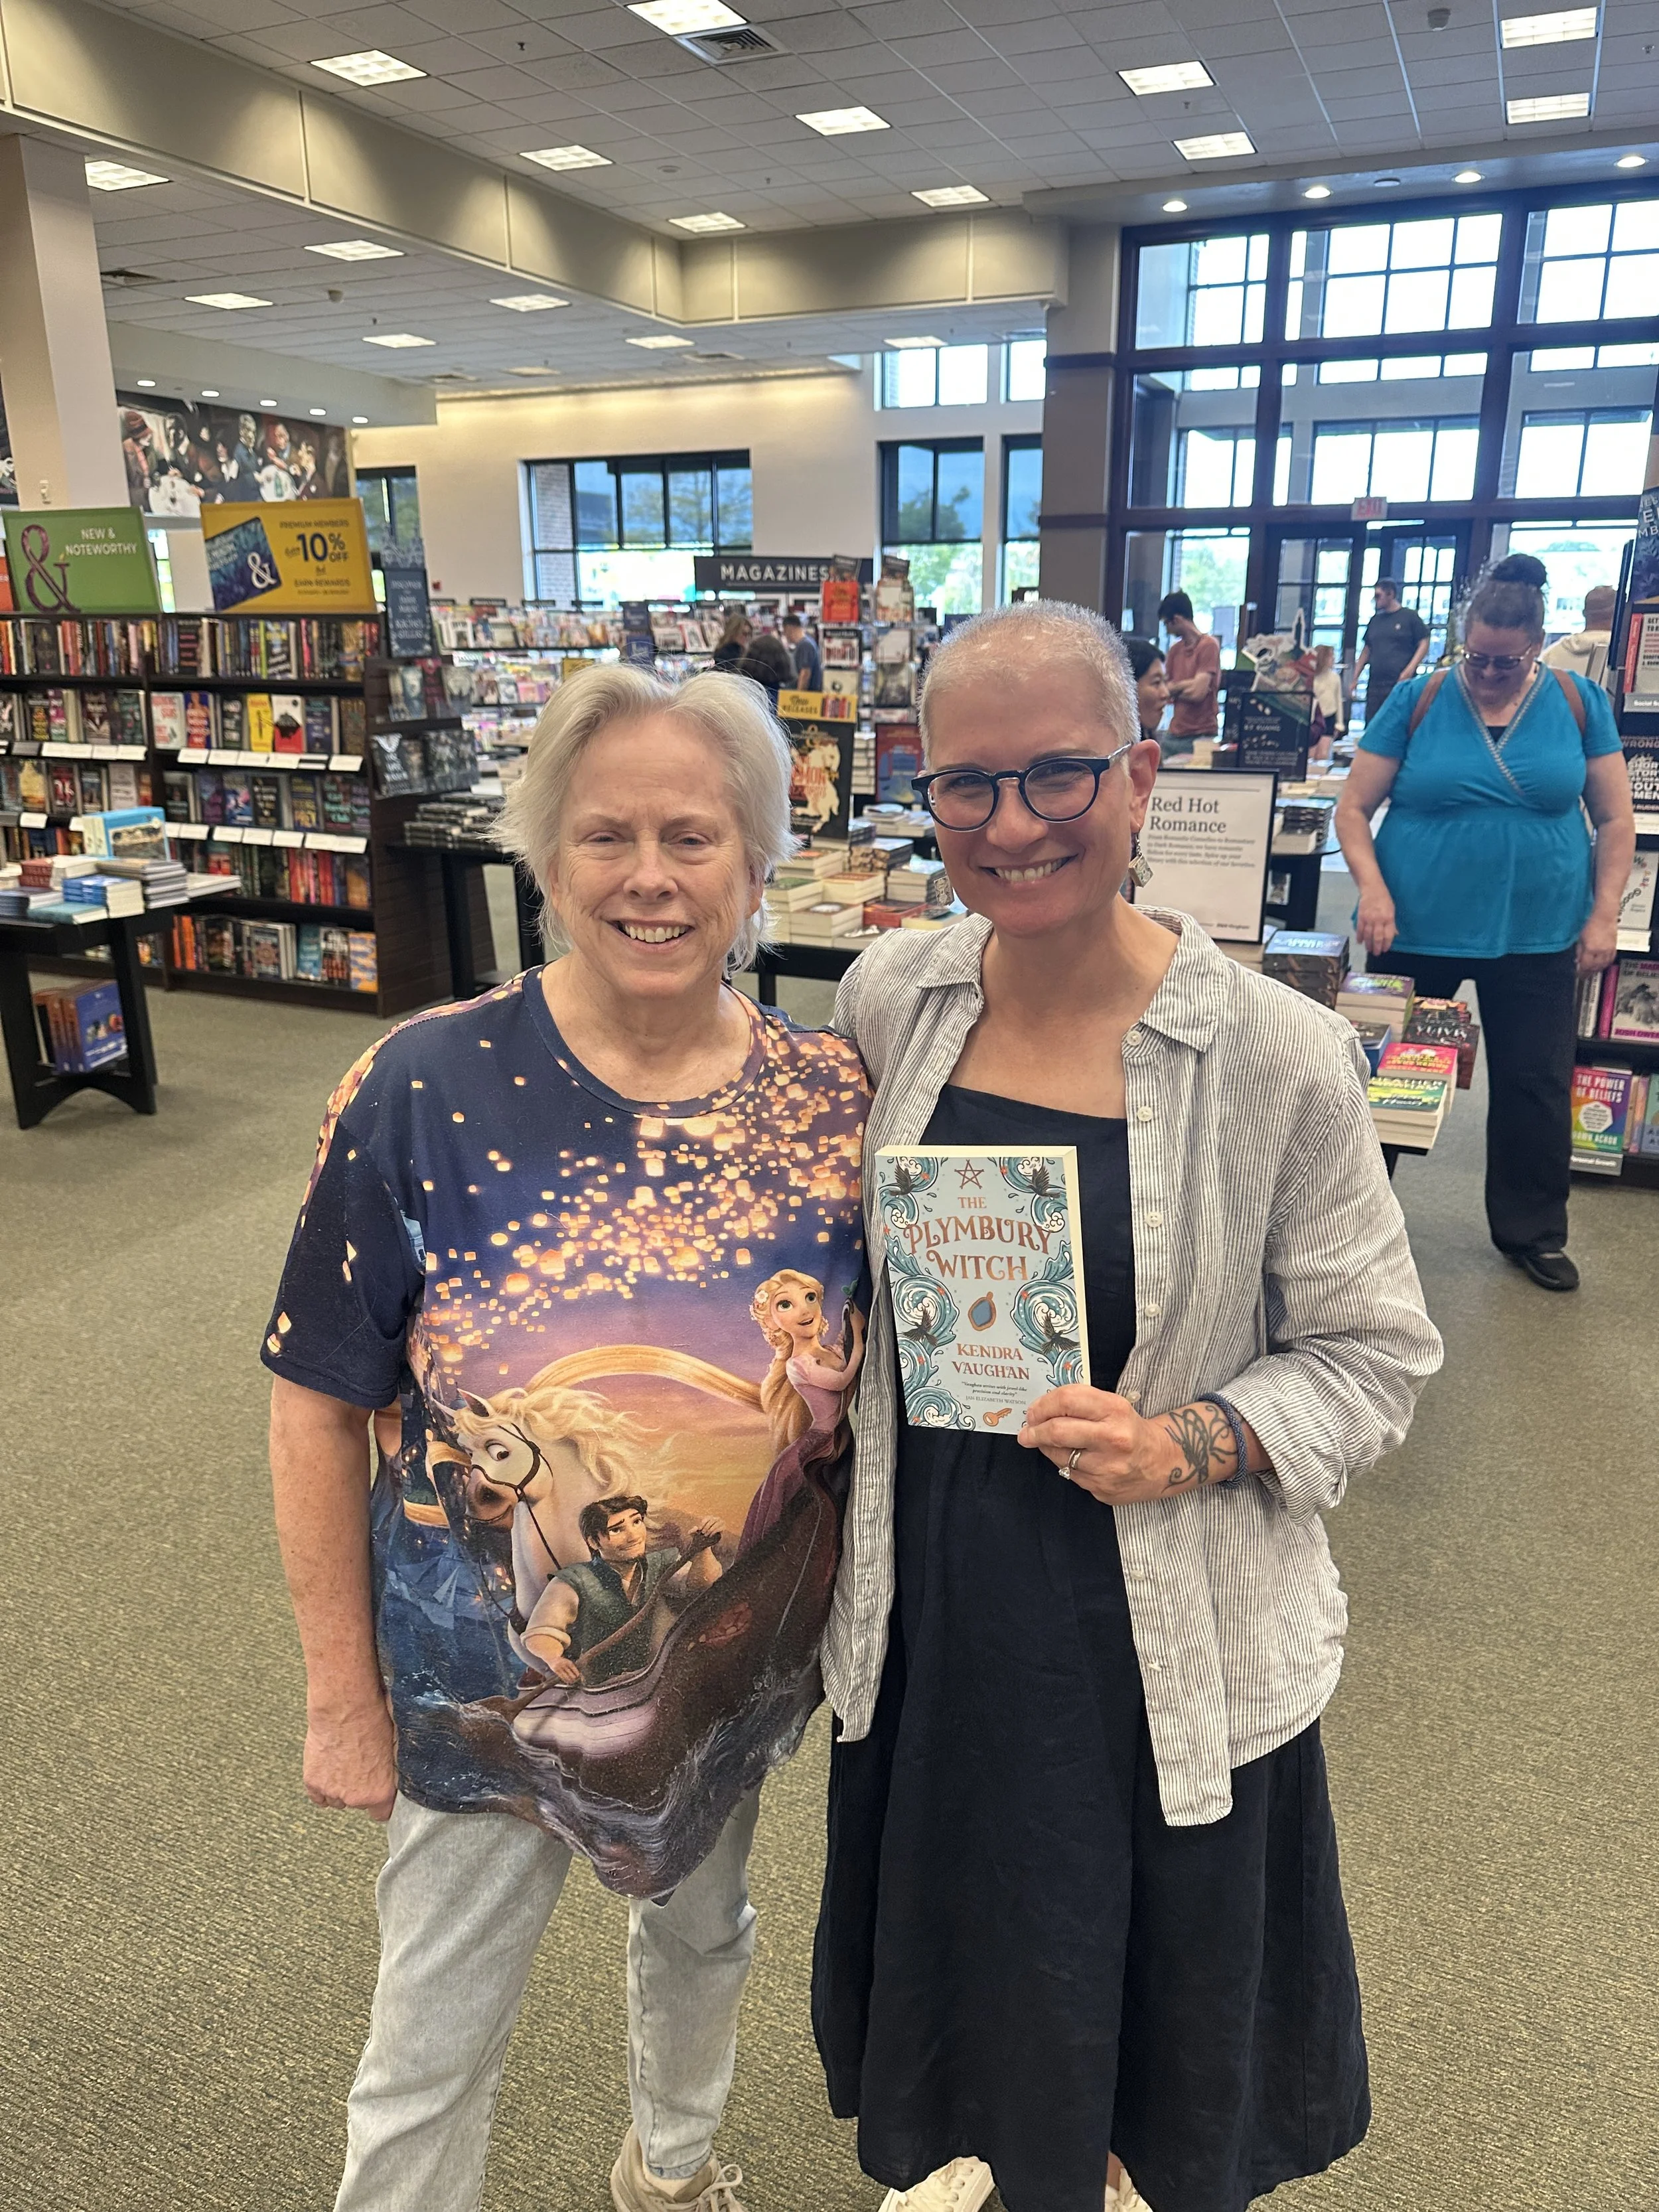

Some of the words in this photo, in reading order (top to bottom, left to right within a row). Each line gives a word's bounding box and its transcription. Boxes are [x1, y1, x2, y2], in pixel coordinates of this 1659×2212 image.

[280, 520, 311, 529] PREMIUM
[313, 519, 350, 528] MEMBERS
[80, 528, 106, 540] NEW
[108, 527, 116, 539] &
[65, 542, 137, 556] NOTEWORTHY
[329, 552, 348, 563] OFF
[721, 563, 830, 581] MAGAZINES
[1151, 796, 1183, 812] Red
[1189, 797, 1220, 814] Hot
[1149, 816, 1226, 834] Romance
[1576, 1087, 1587, 1097] OF
[1577, 1074, 1593, 1088] THE
[1593, 1076, 1625, 1092] POWER
[958, 1196, 987, 1209] THE
[902, 1215, 1051, 1255] PLYMBURY
[926, 1249, 1028, 1281] WITCH
[956, 1343, 1024, 1361] KENDRA
[952, 1361, 1030, 1380] VAUGHAN
